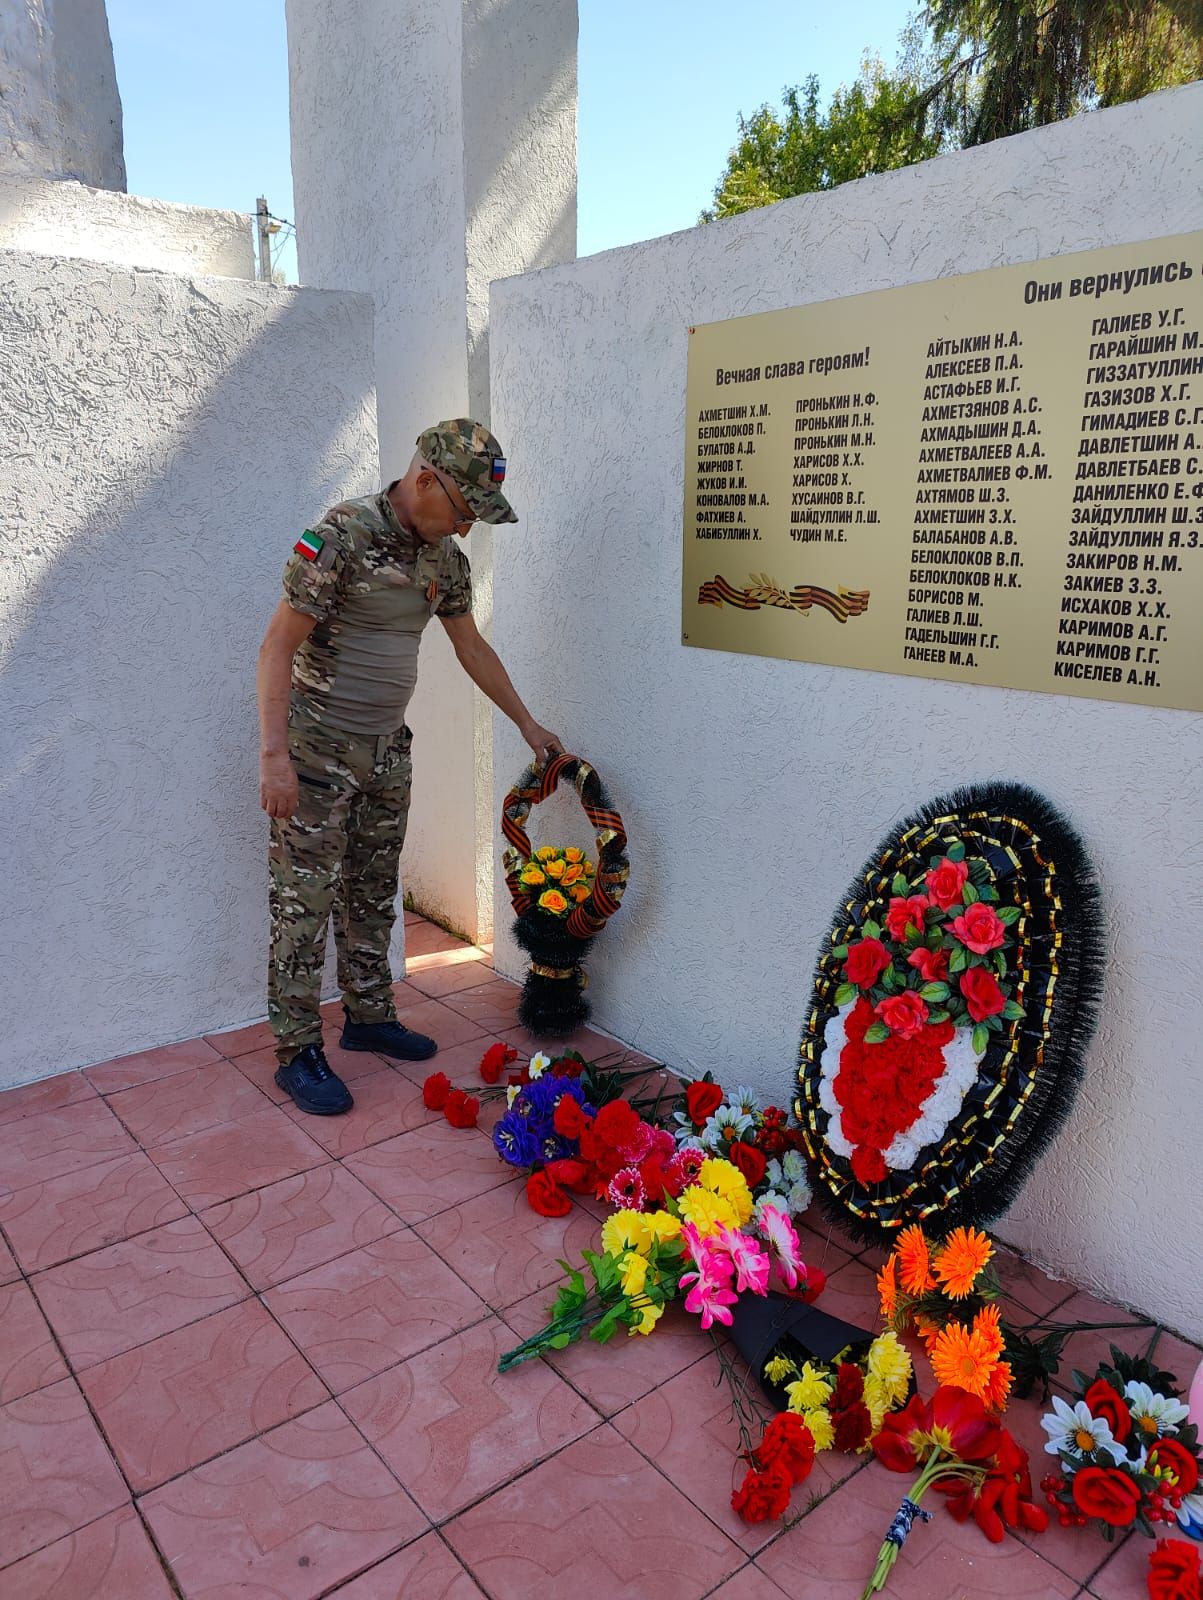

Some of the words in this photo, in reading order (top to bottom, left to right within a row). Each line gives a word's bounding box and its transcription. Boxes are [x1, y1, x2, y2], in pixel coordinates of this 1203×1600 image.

[1024, 281, 1062, 304] Они
[1069, 261, 1193, 299] вернулись
[1092, 312, 1152, 336] ГАЛИЕВ
[1158, 308, 1185, 328] У.Г.
[926, 334, 991, 358] АЙТЫКИН
[994, 331, 1023, 349] Н.А.
[1089, 334, 1177, 360] ГАРАЙШИН
[716, 367, 760, 386] Вечная
[765, 361, 804, 379] слава
[809, 346, 870, 376] героям!
[925, 357, 991, 379] АЛЕКСЕЕВ
[995, 354, 1023, 371] П.А.
[923, 379, 992, 401] АСТАФЬЕВ
[996, 376, 1020, 394] И.Г.
[1084, 386, 1155, 408] ГАЗИЗОВ
[1160, 383, 1191, 402] Х.Г.
[698, 406, 747, 422] АХМЕТШИН
[749, 403, 771, 418] Х.М.
[796, 394, 850, 413] ПРОНЬКИН
[853, 392, 879, 407] Н.Ф.
[922, 400, 1009, 422] АХМЕТЗЯНОВ
[1013, 397, 1042, 414] А.С.
[698, 423, 754, 439] БЕЛОКЛОКОВ
[756, 422, 766, 435] П.
[795, 414, 849, 432] ПРОНЬКИН
[851, 412, 874, 427] Л.Н.
[920, 421, 1009, 442] АХМАДЫШИН
[1011, 420, 1041, 439] Д.А.
[1081, 410, 1170, 432] ГИМАДИЕВ
[698, 442, 735, 456] БУЛАТОВ
[737, 441, 756, 455] А.Д.
[794, 434, 848, 450] ПРОНЬКИН
[851, 432, 876, 447] М.Н.
[1077, 433, 1179, 457] ДАВЛЕТШИН
[1183, 433, 1203, 450] А.
[793, 454, 839, 469] ХАРИСОВ
[842, 452, 864, 467] Х.Х.
[918, 444, 1012, 463] АХМЕТВАЛЕЕВ
[1016, 442, 1045, 458] А.А.
[697, 460, 734, 474] ЖИРНОВ
[736, 459, 743, 472] Т.
[917, 466, 1011, 483] АХМЕТВАЛИЕВ
[1015, 464, 1052, 480] Ф.М.
[1075, 458, 1181, 480] ДАВЛЕТБАЕВ
[697, 477, 727, 490] ЖУКОВ
[792, 473, 838, 487] ХАРИСОВ
[841, 472, 852, 486] Х.
[696, 494, 746, 507] КОНОВАЛОВ
[748, 493, 769, 506] М.А.
[792, 491, 843, 506] ХУСАИНОВ
[846, 491, 865, 504] В.Г.
[915, 488, 975, 504] АХТЯМОВ
[978, 487, 1010, 503] Ш.З.
[1072, 482, 1169, 503] ДАНИЛЕНКО
[696, 511, 735, 523] ФАТХИЕВ
[737, 511, 746, 523] А.
[791, 507, 853, 525] ШАЙДУЛЛИН
[855, 510, 880, 524] Л.Ш.
[914, 509, 985, 524] АХМЕТШИН
[989, 509, 1016, 524] З.Х.
[1071, 504, 1167, 526] ЗАЙДУЛЛИН
[696, 527, 751, 540] ХАБИБУЛЛИН
[752, 528, 762, 540] Х.
[790, 529, 822, 543] ЧУДИН
[824, 529, 847, 542] М.Е.
[913, 530, 986, 545] БАЛАБАНОВ
[989, 530, 1017, 545] А.В.
[1068, 527, 1164, 549] ЗАЙДУЛЛИН
[911, 549, 992, 566] БЕЛОКЛОКОВ
[996, 552, 1024, 567] В.П.
[1066, 553, 1138, 570] ЗАКИРОВ
[1143, 555, 1182, 572] Н.М.
[909, 569, 990, 586] БЕЛОКЛОКОВ
[994, 572, 1022, 588] Н.К.
[1064, 575, 1124, 593] ЗАКИЕВ
[1128, 577, 1162, 595] З.З.
[908, 589, 964, 605] БОРИСОВ
[906, 608, 950, 624] ГАЛИЕВ
[953, 611, 983, 627] Л.Ш.
[1061, 597, 1132, 616] ИСХАКОВ
[1136, 601, 1171, 619] Х.Х.
[905, 627, 977, 647] ГАДЕЛЬШИН
[980, 633, 999, 649] Г.Г.
[1059, 619, 1134, 639] КАРИМОВ
[1137, 624, 1167, 642] А.Г.
[904, 646, 946, 663] ГАНЕЕВ
[949, 650, 978, 667] М.А.
[1056, 640, 1131, 661] КАРИМОВ
[1135, 647, 1160, 664] Г.Г.
[1054, 661, 1123, 683] КИСЕЛЕВ
[1126, 669, 1160, 687] А.Н.
